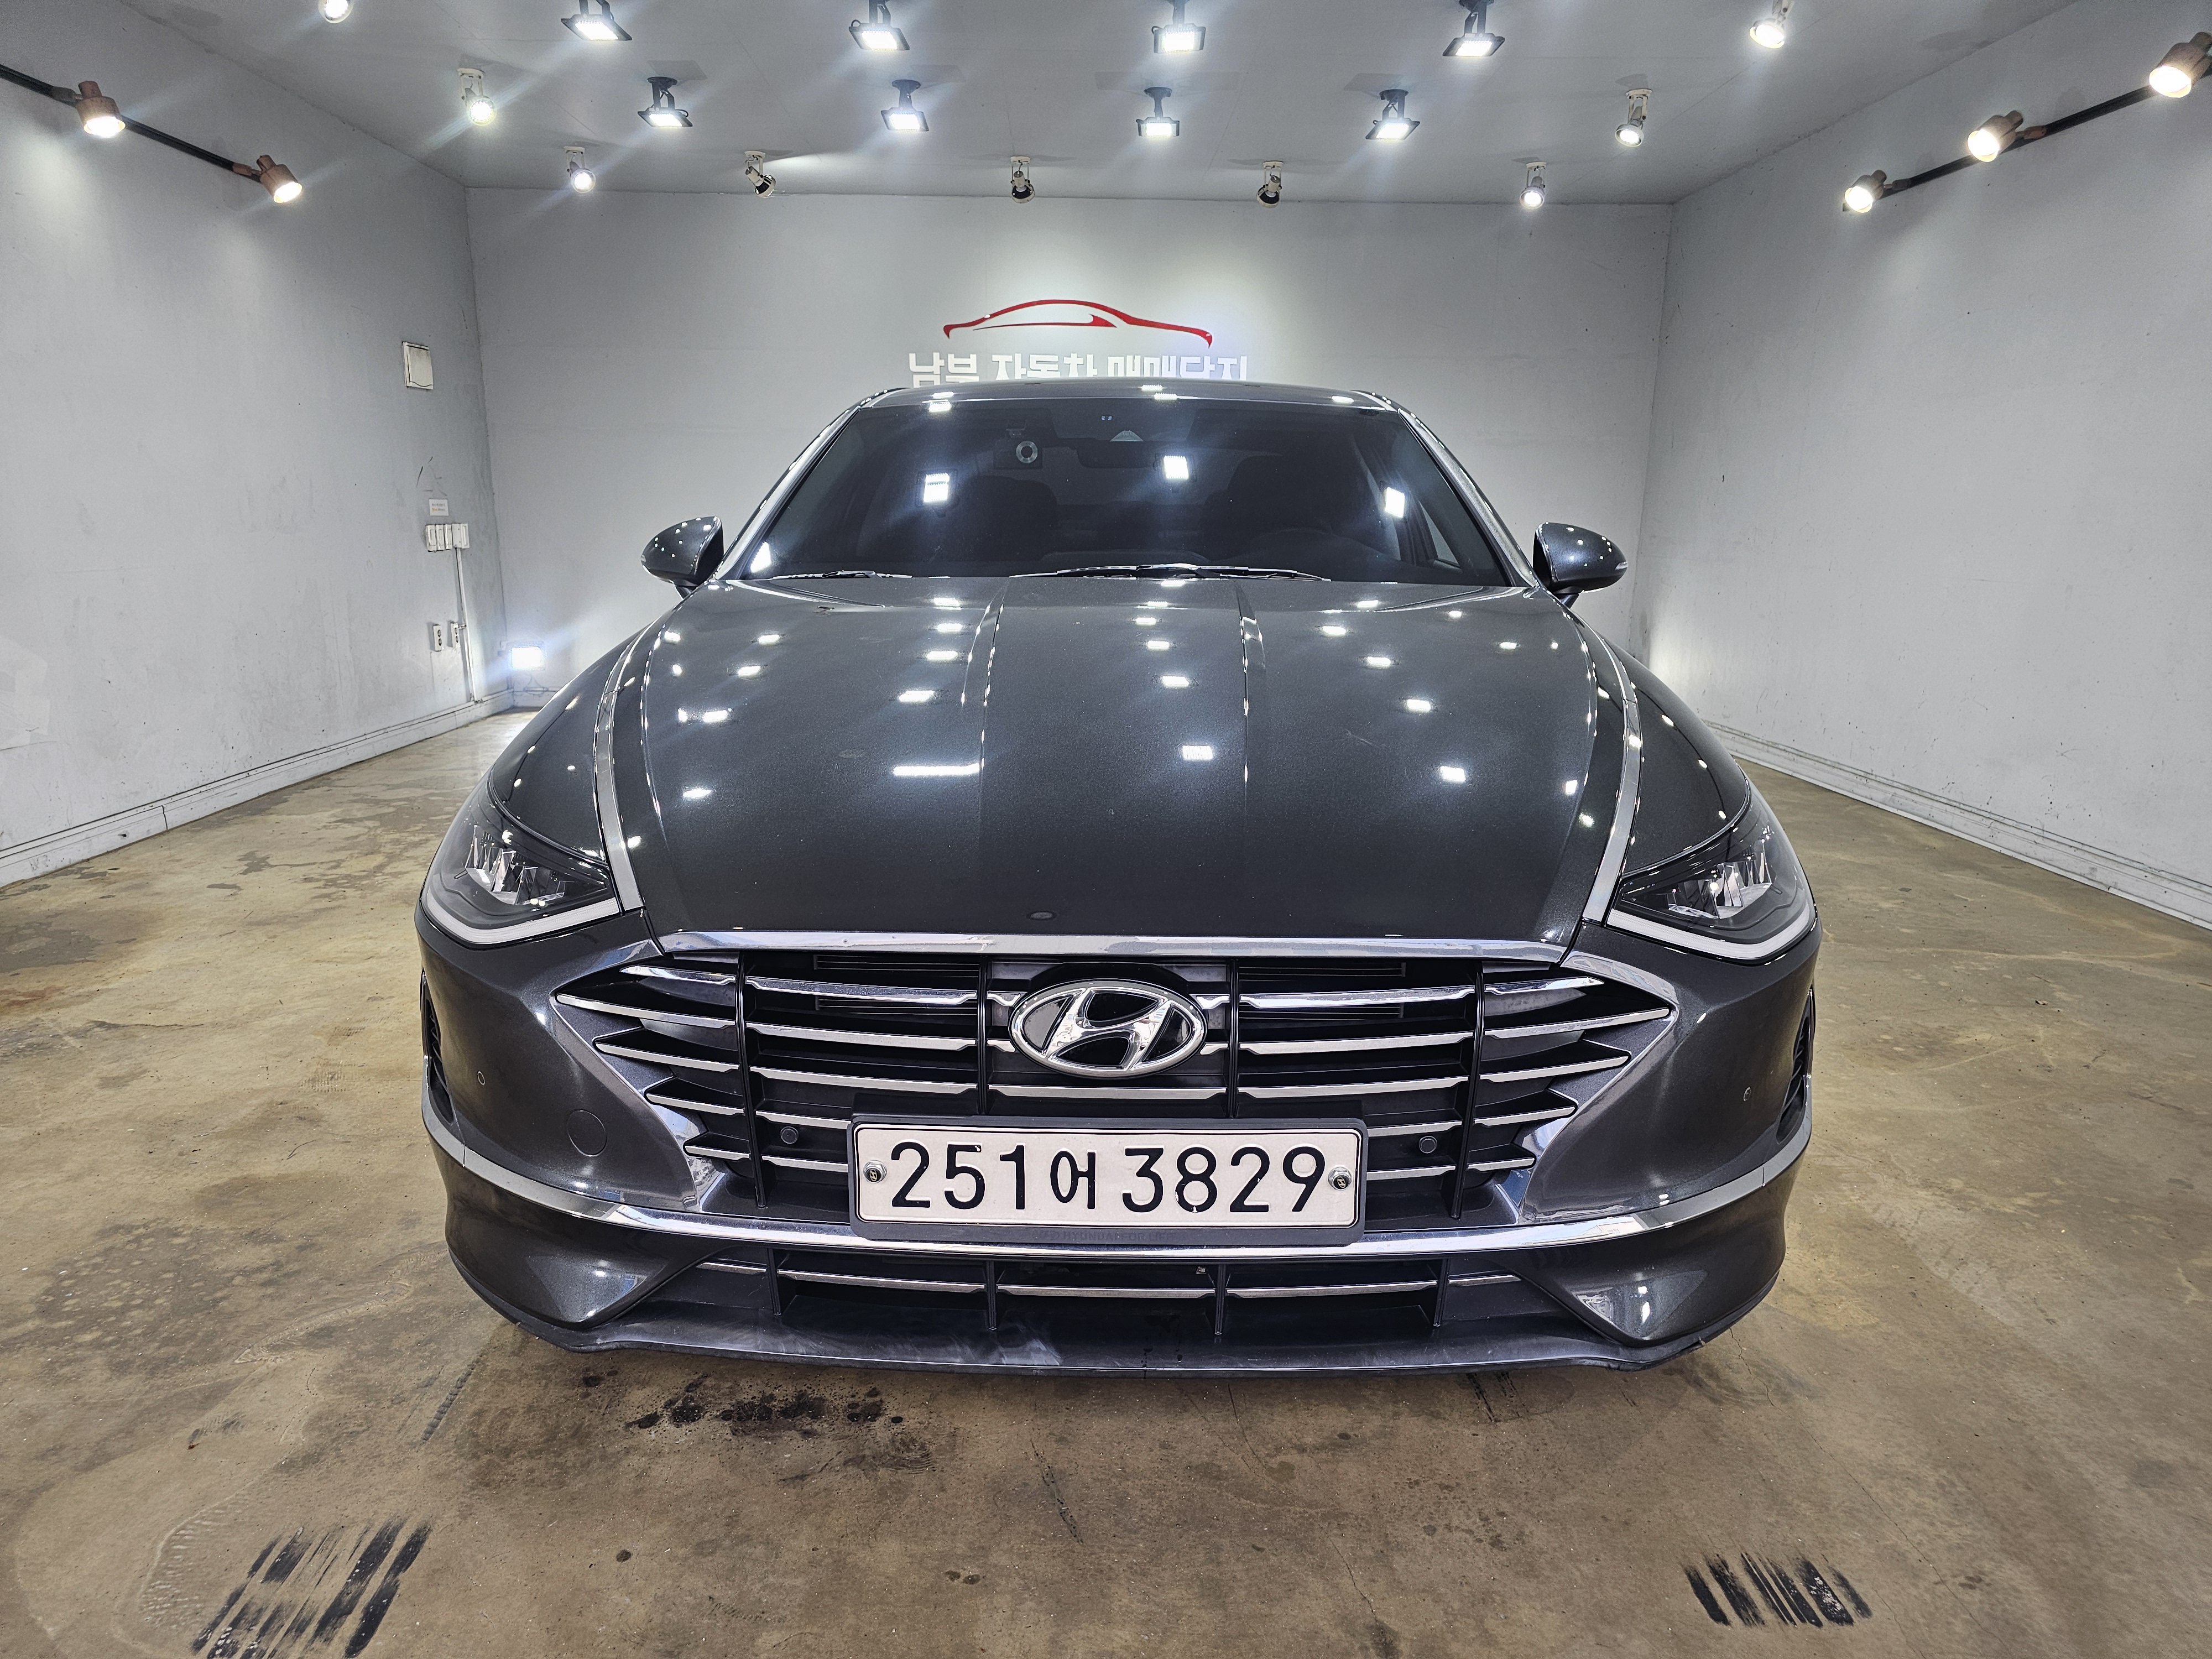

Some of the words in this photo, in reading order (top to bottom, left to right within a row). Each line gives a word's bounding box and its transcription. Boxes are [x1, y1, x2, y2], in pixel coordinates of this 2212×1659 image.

[909, 352, 979, 388] 남부
[992, 353, 1098, 380] 자동차
[890, 1141, 1096, 1211] 251어
[1121, 1145, 1326, 1213] 3829
